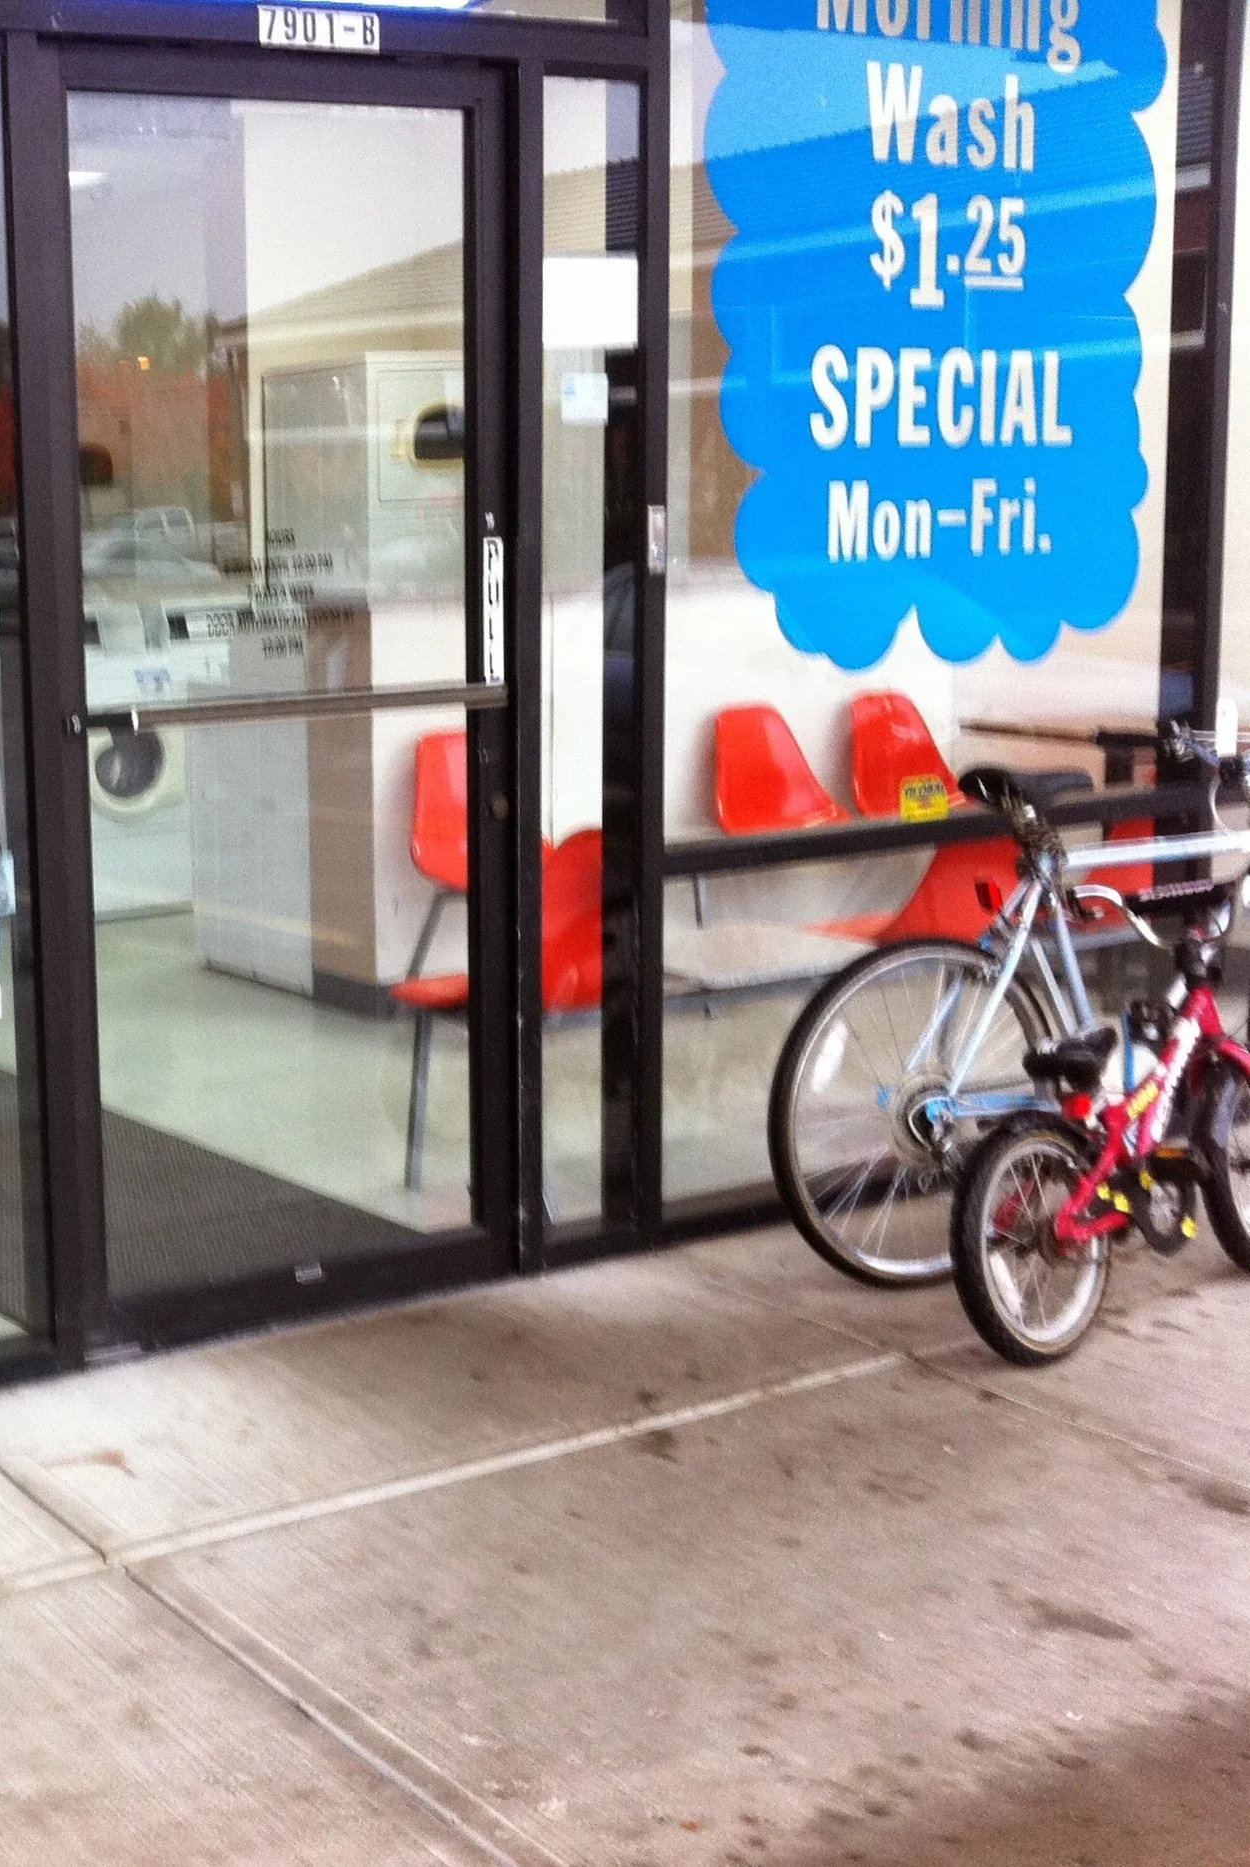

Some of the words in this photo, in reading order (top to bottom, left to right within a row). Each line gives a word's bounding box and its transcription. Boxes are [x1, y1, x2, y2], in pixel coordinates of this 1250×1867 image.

[261, 8, 375, 45] 7901-B
[866, 60, 1035, 172] Wash
[869, 189, 1027, 309] $1.25
[809, 343, 1073, 450] SPECIAL
[827, 477, 1052, 563] Mon-Fri.
